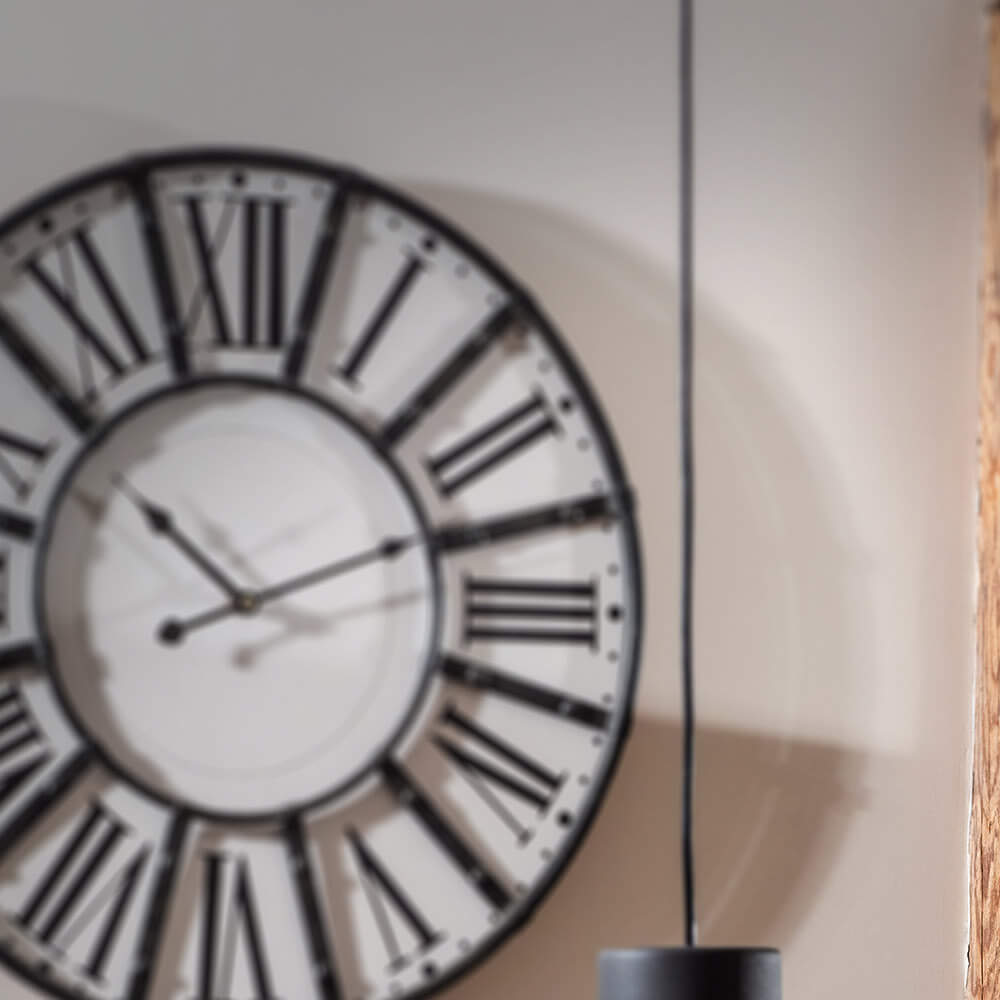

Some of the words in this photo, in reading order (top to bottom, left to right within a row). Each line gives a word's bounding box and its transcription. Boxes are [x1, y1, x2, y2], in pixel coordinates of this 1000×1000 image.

[18, 221, 164, 406] XI
[175, 192, 295, 350] XII
[330, 246, 428, 392] I
[424, 388, 562, 498] II
[462, 572, 600, 652] III
[12, 796, 152, 986] VII
[346, 824, 444, 972] V
